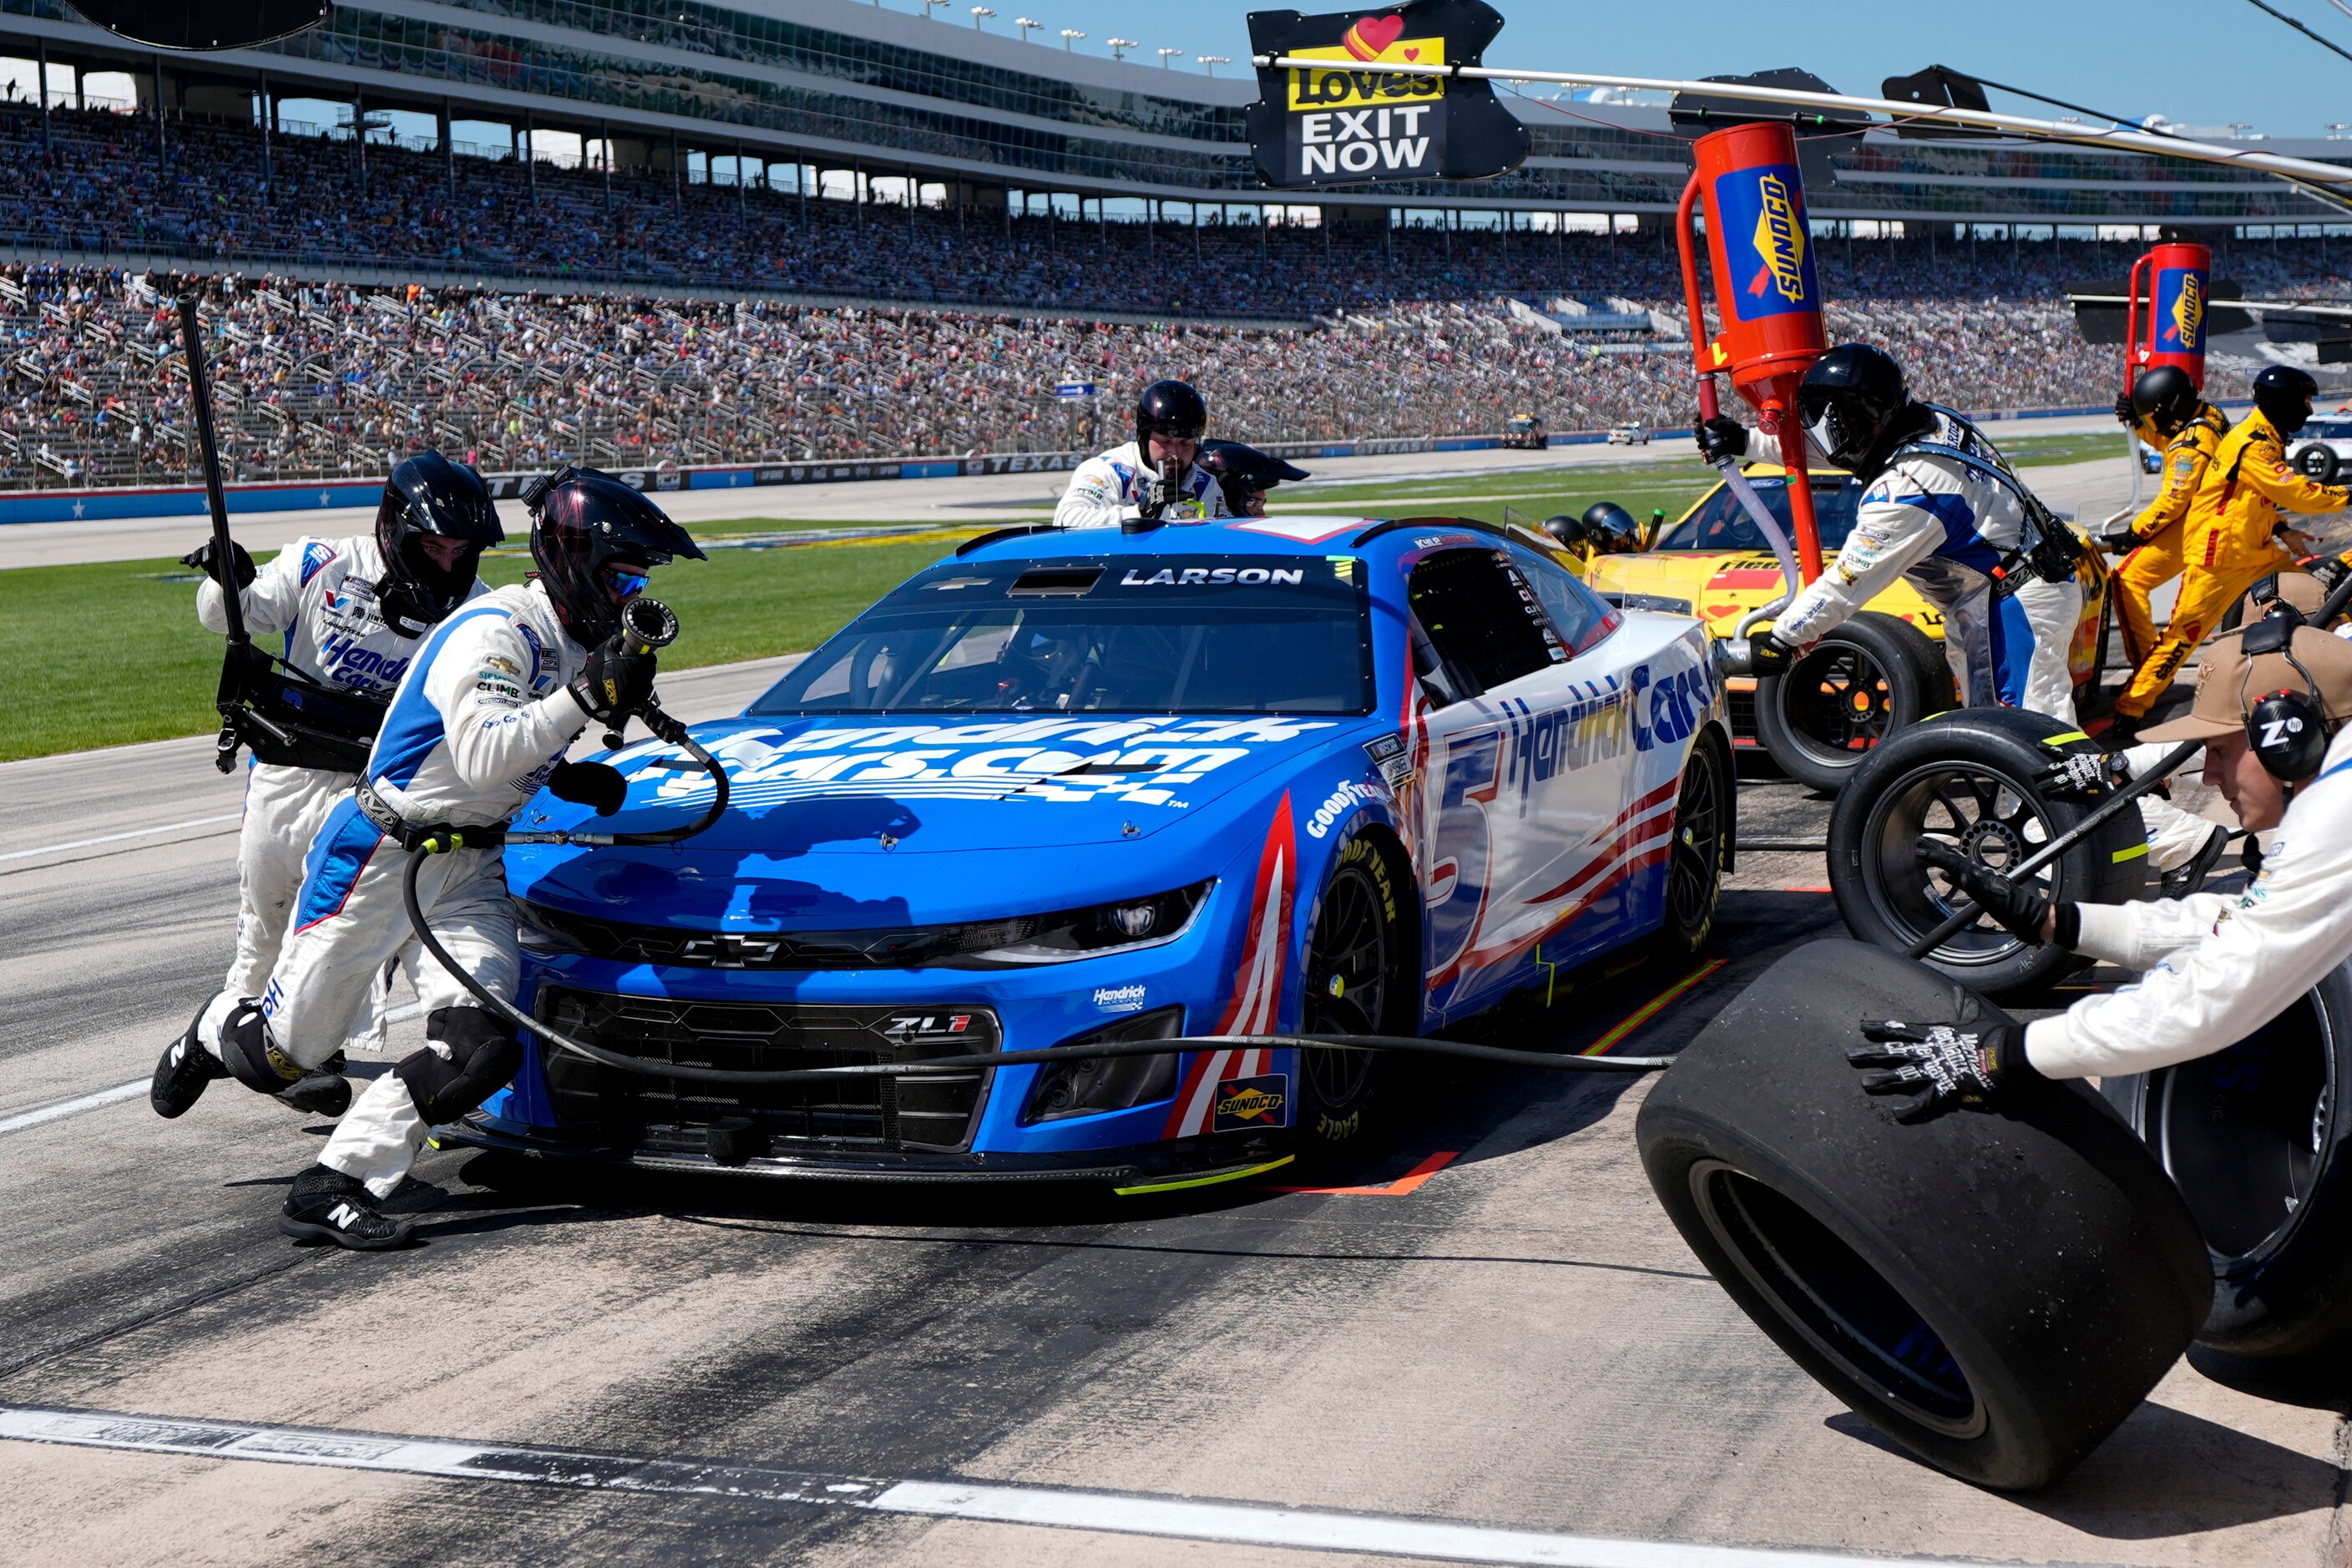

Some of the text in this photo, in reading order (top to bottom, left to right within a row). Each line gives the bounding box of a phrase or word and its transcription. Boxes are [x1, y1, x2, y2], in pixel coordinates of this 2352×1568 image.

[1302, 105, 1430, 143] EXIT
[1302, 137, 1430, 175] NOW
[1763, 180, 1801, 296] SUNOCO
[2183, 276, 2198, 345] SUNOCO
[1368, 442, 1420, 453] TEXAS
[991, 454, 1083, 473] TEXAS
[1847, 553, 1869, 569] CLIMB
[1120, 569, 1303, 585] LARSON
[322, 620, 366, 638] GOODYEAR
[2259, 720, 2289, 748] Z
[1426, 725, 1505, 991] 5
[1094, 984, 1146, 1006] Hendrick
[885, 1014, 971, 1034] ZL1
[1220, 1095, 1280, 1113] SUNOCO
[327, 1203, 359, 1230] N
